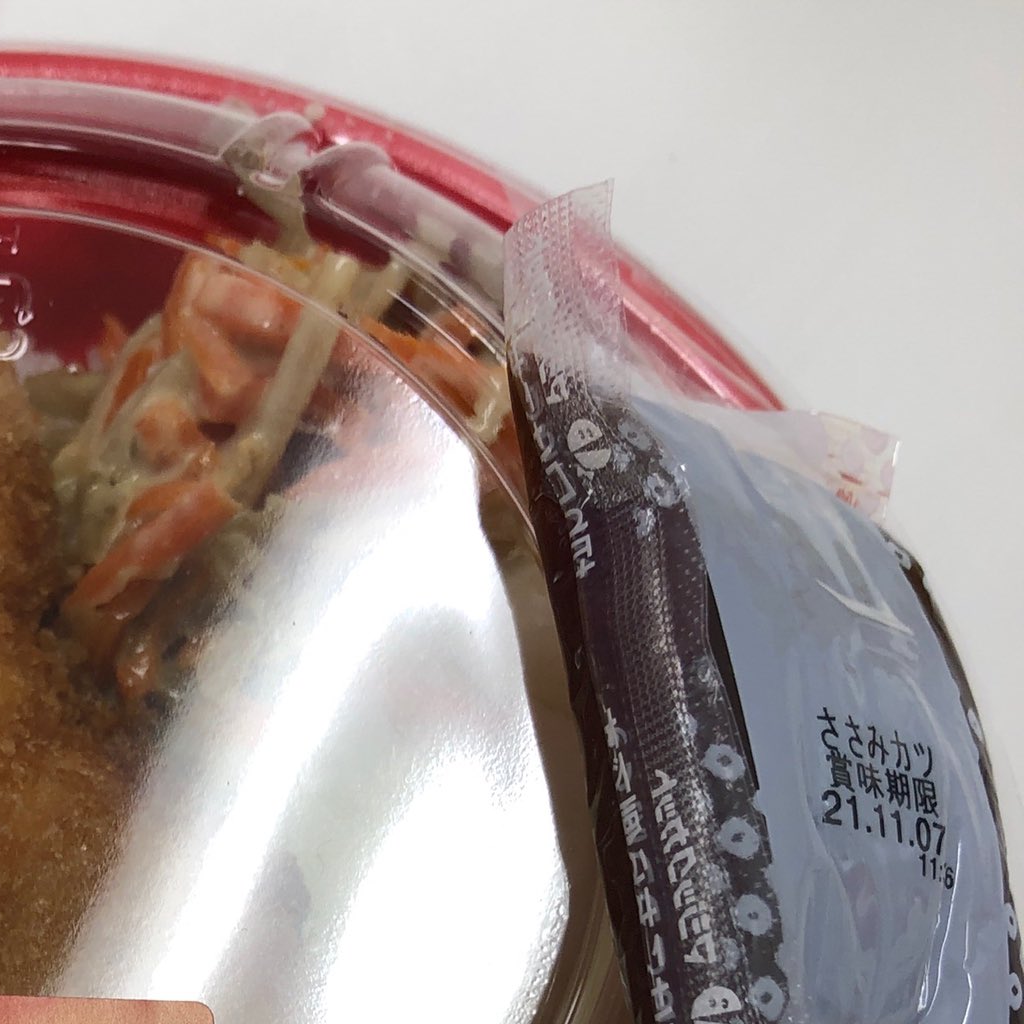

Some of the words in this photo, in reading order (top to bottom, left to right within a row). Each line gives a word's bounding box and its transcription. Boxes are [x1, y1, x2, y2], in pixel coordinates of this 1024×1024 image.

[817, 707, 933, 777] ささみカツ
[825, 748, 939, 818] 賞味期限
[821, 790, 946, 855] 21.11.07
